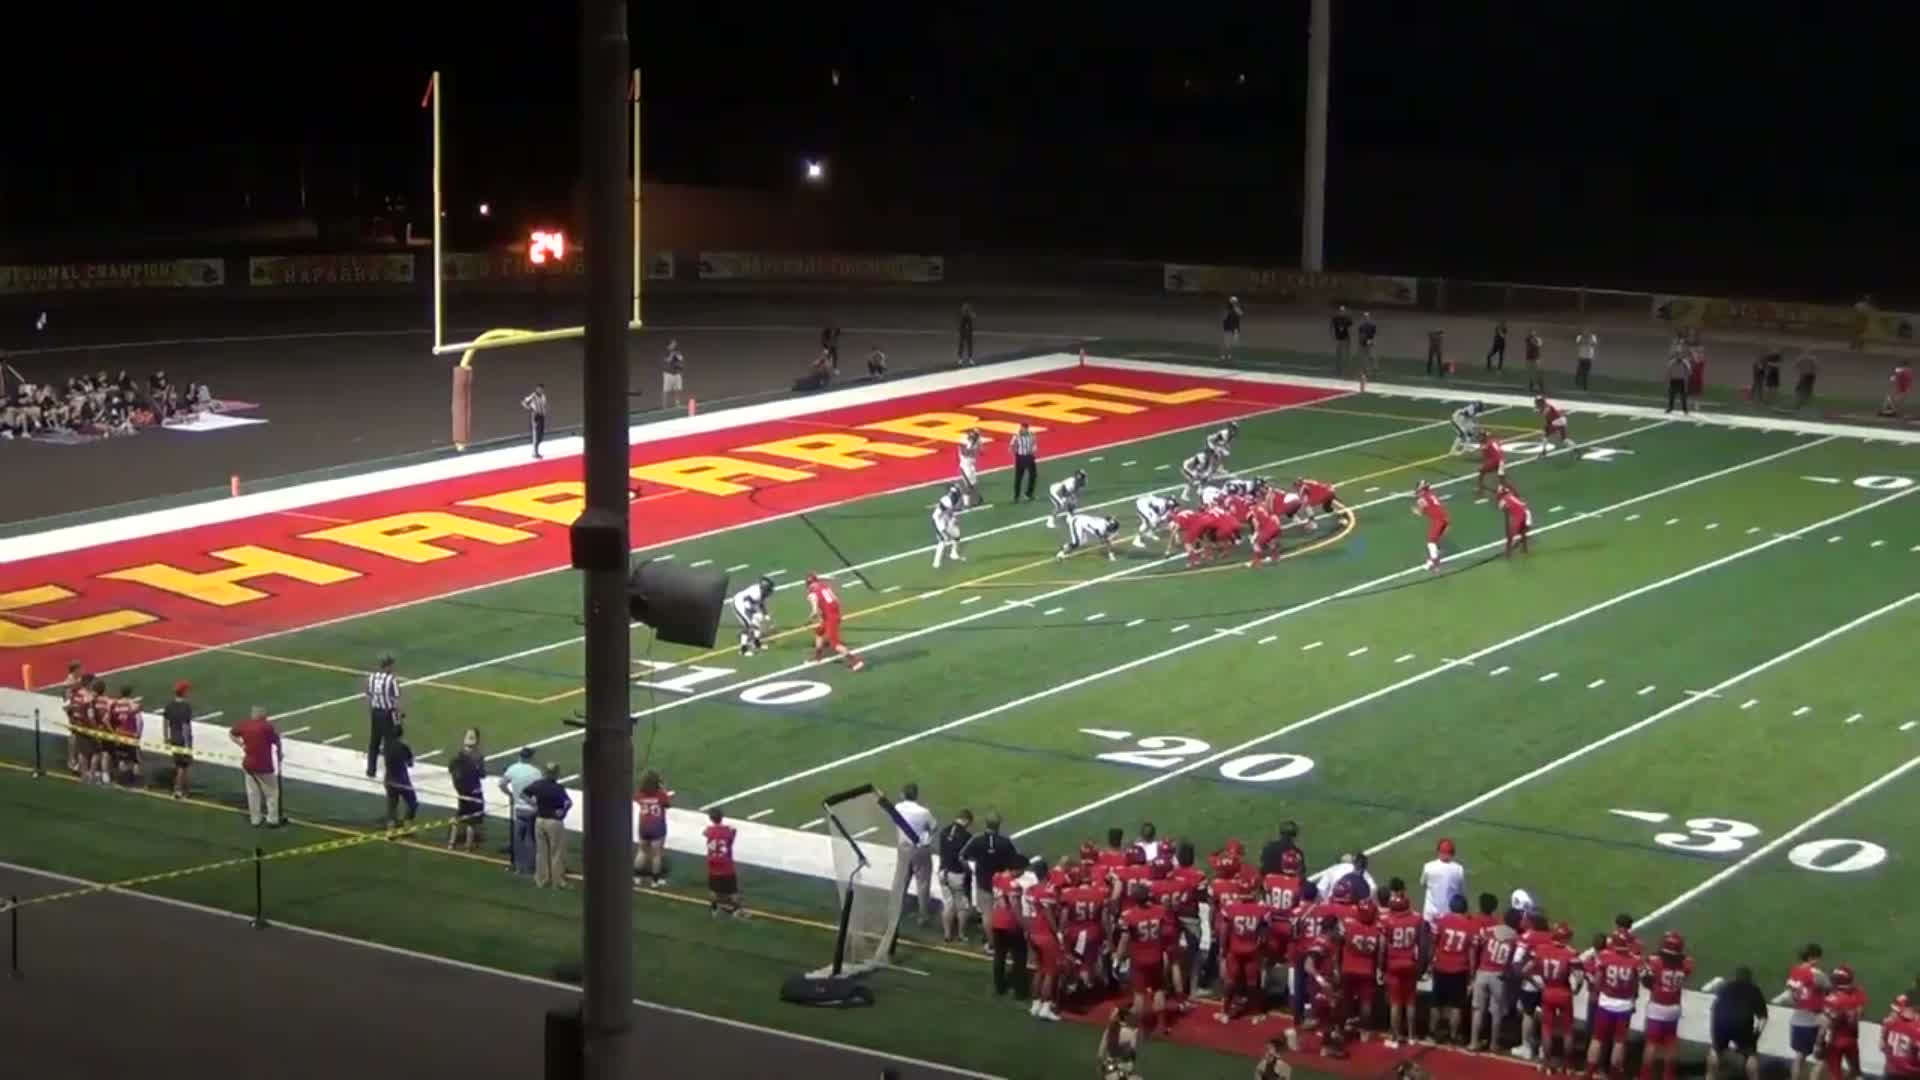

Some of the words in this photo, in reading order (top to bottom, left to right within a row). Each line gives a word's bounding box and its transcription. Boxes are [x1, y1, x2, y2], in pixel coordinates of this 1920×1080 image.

[529, 231, 563, 264] 24
[0, 383, 1229, 648] CHAPARRAL
[1096, 735, 1314, 783] 20
[1654, 817, 1888, 873] 30
[1075, 901, 1094, 920] 51
[1137, 919, 1161, 941] 52
[1233, 916, 1257, 936] 54
[1443, 928, 1466, 951] 77
[1487, 938, 1511, 964] 40
[1543, 958, 1561, 979] 17
[1606, 965, 1632, 987] 94
